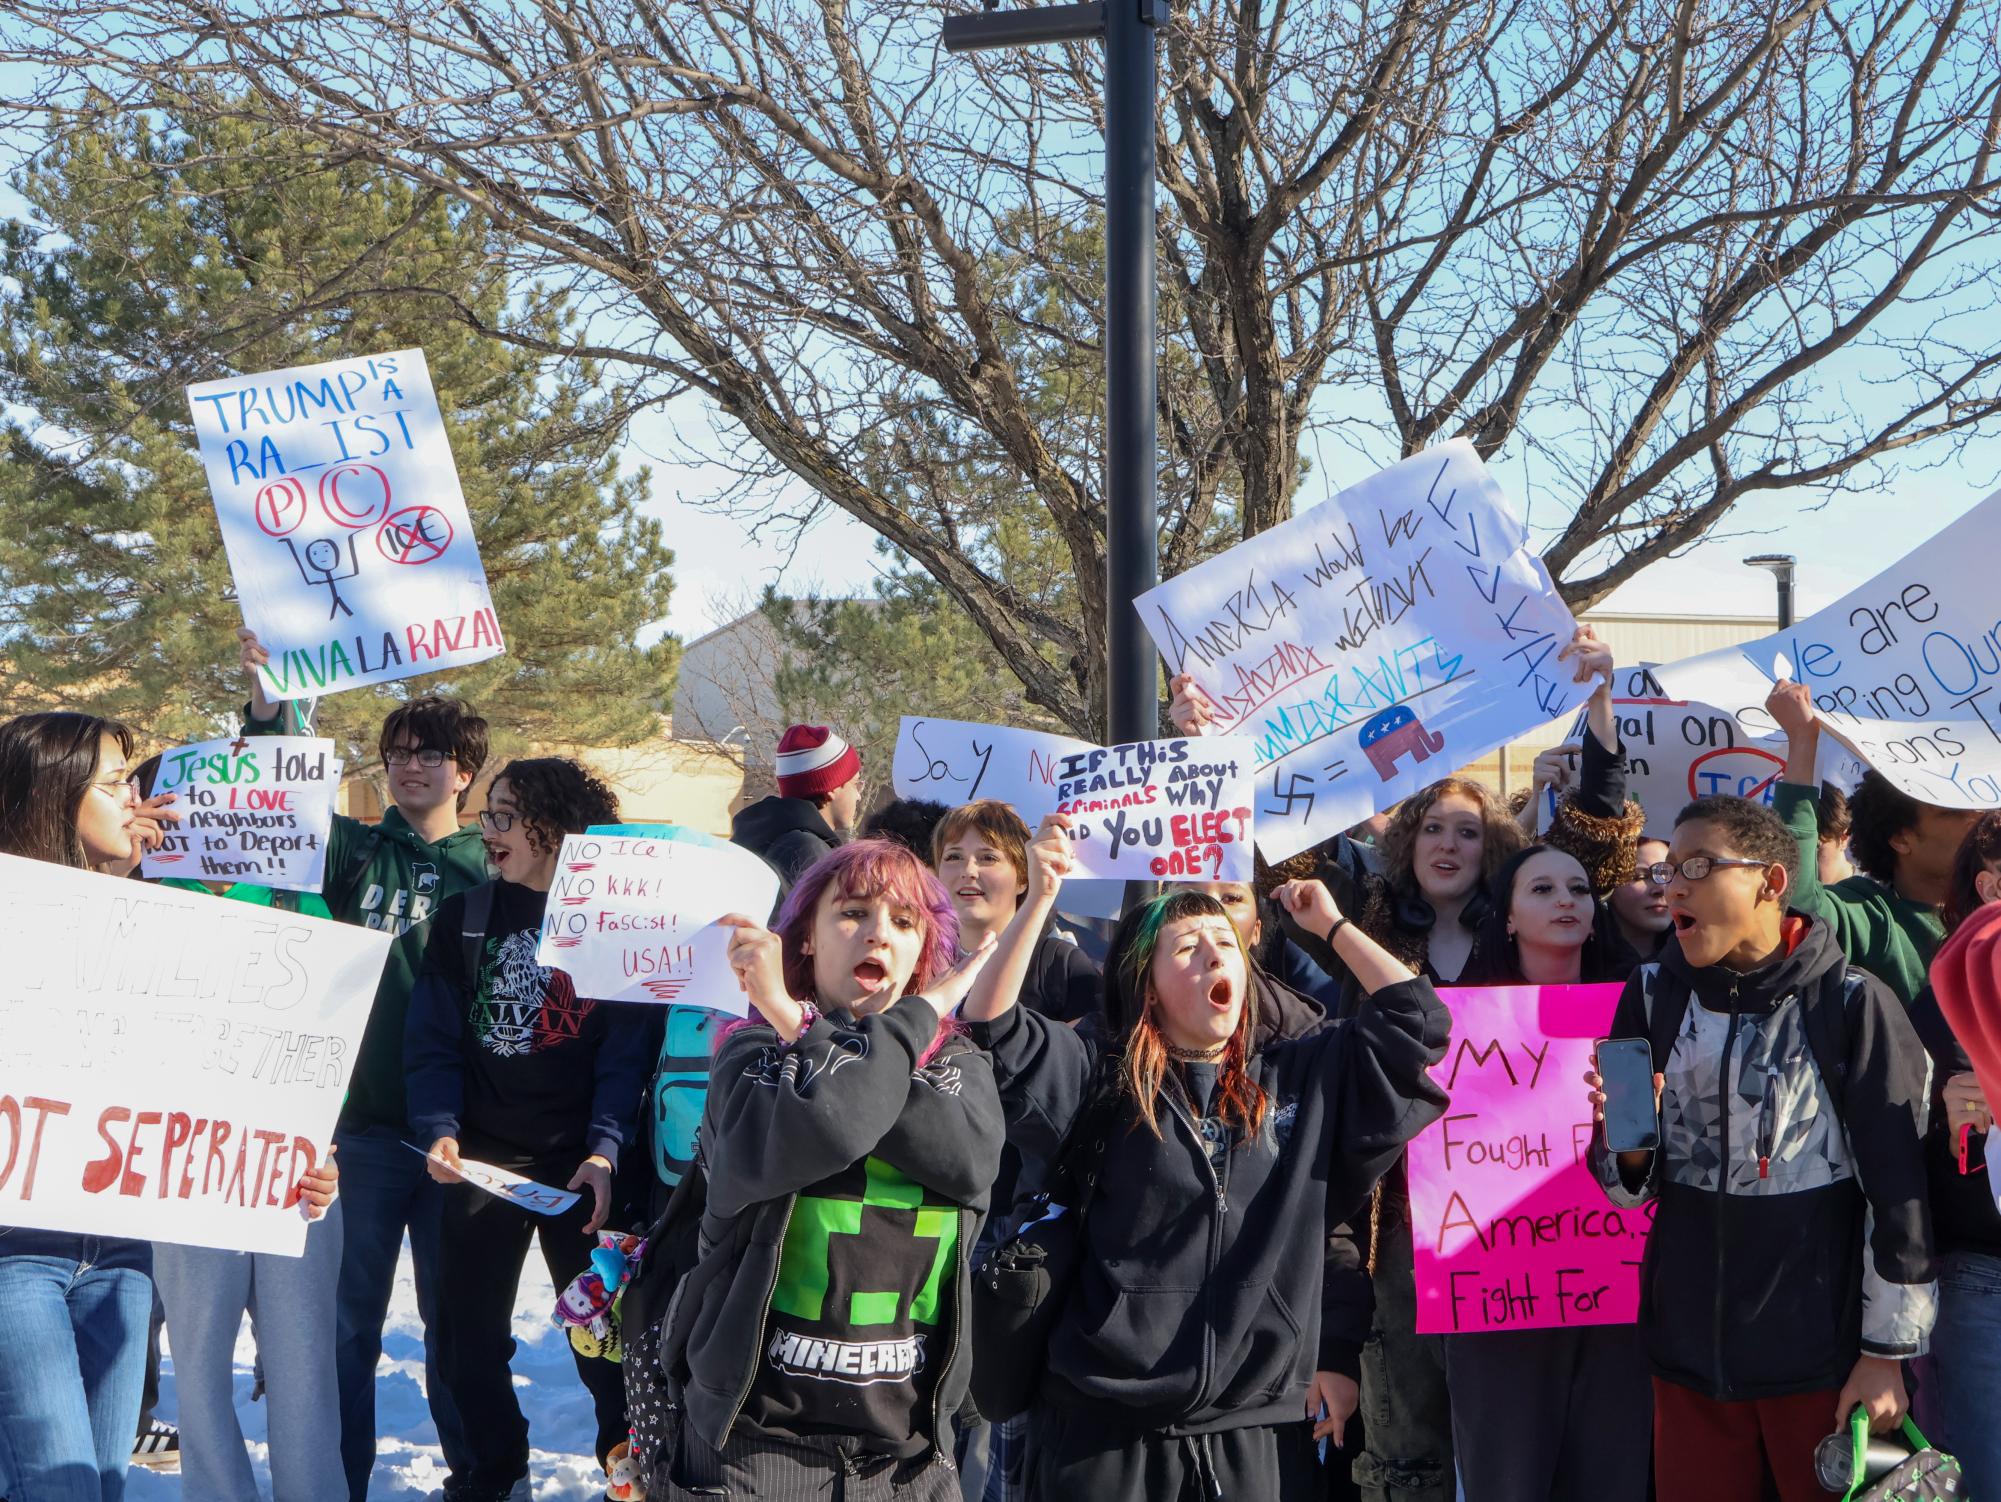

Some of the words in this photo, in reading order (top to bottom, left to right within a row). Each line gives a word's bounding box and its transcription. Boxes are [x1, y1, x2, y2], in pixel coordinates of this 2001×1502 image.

[194, 371, 367, 433] TRUMP
[368, 357, 399, 380] IS
[382, 379, 404, 401] A
[385, 513, 446, 555] ICE
[1850, 584, 1938, 655] are
[261, 640, 355, 693] VIVA
[355, 631, 402, 673] LA
[1682, 716, 1734, 749] on
[1950, 686, 2001, 744] T
[272, 747, 325, 782] told
[909, 721, 993, 800] Say
[1028, 749, 1058, 787] N
[184, 785, 216, 807] to
[229, 787, 303, 812] LOVE
[1058, 765, 1152, 801] REALLY
[1920, 762, 2001, 803] Yo
[190, 811, 297, 836] neighbors
[1171, 807, 1252, 847] ELECT
[202, 835, 229, 851] to
[240, 830, 320, 856] Deport
[562, 842, 602, 865] NO
[554, 875, 595, 898] NO
[547, 911, 587, 937] NO
[623, 945, 696, 977] USA!!
[82, 1105, 317, 1210] SEPERATED
[1443, 1113, 1552, 1170] Fought
[1450, 1270, 1539, 1331] Fight
[1556, 1268, 1611, 1324] For
